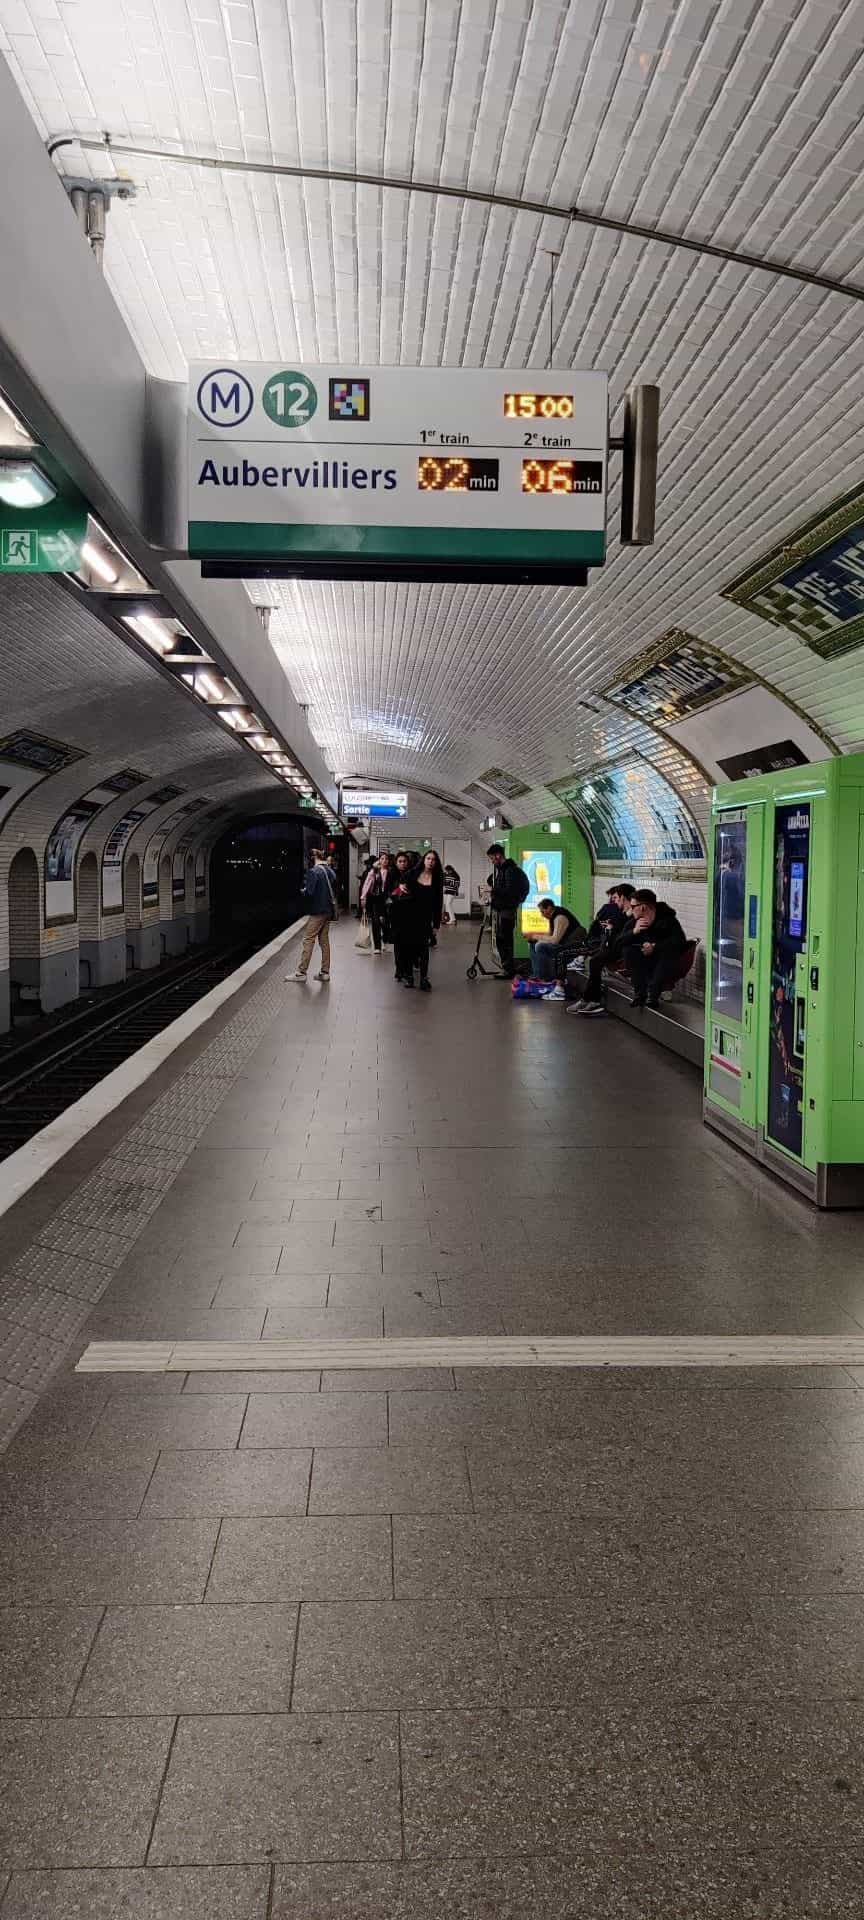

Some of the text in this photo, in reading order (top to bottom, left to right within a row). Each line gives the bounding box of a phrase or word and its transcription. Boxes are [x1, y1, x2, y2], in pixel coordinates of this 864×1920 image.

[210, 382, 310, 416] M 12
[419, 430, 470, 445] 1er train
[523, 433, 572, 448] 2e train
[197, 459, 398, 490] Aubervilliers
[418, 458, 497, 492] 02 min
[521, 461, 600, 495] 06 min
[343, 805, 371, 815] Sortie
